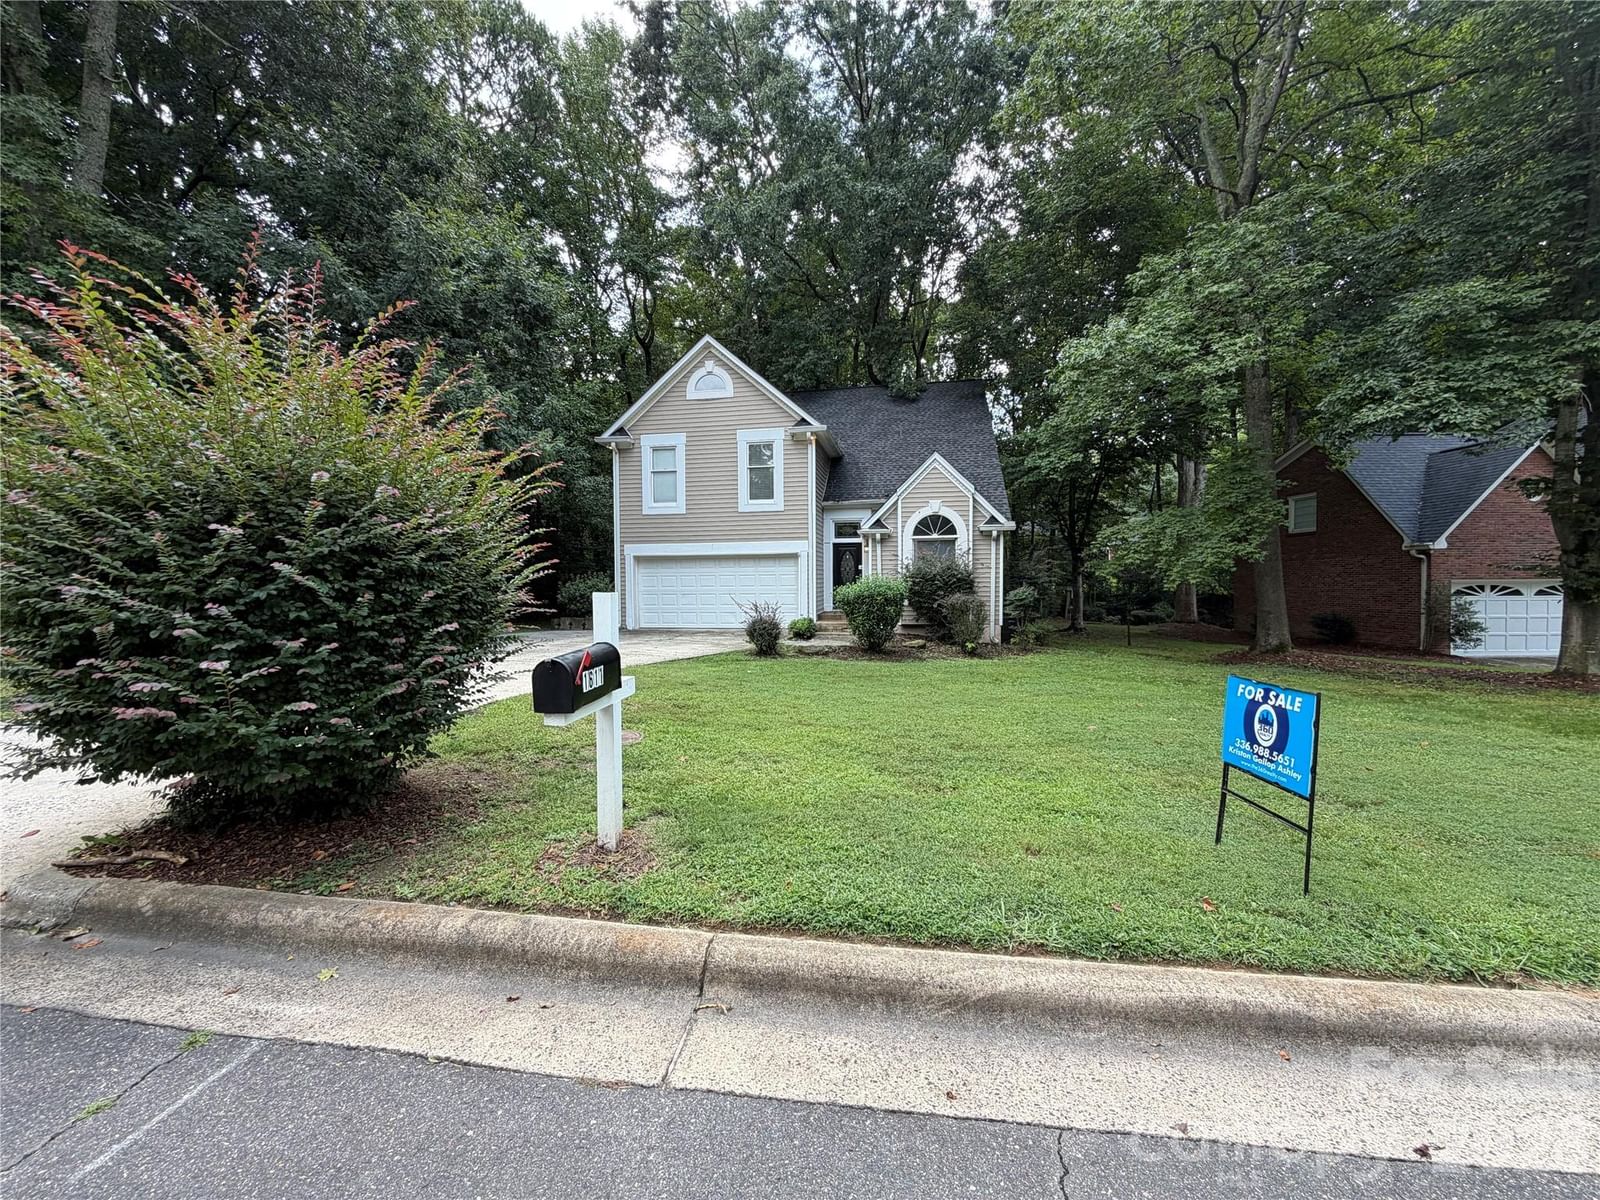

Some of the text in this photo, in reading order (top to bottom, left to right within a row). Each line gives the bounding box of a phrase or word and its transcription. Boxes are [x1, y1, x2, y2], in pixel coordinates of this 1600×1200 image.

[1237, 684, 1303, 712] FOR SALE
[1234, 738, 1295, 768] 336.988.5651
[1252, 754, 1276, 771] Gallop
[1277, 765, 1302, 782] Ashley
